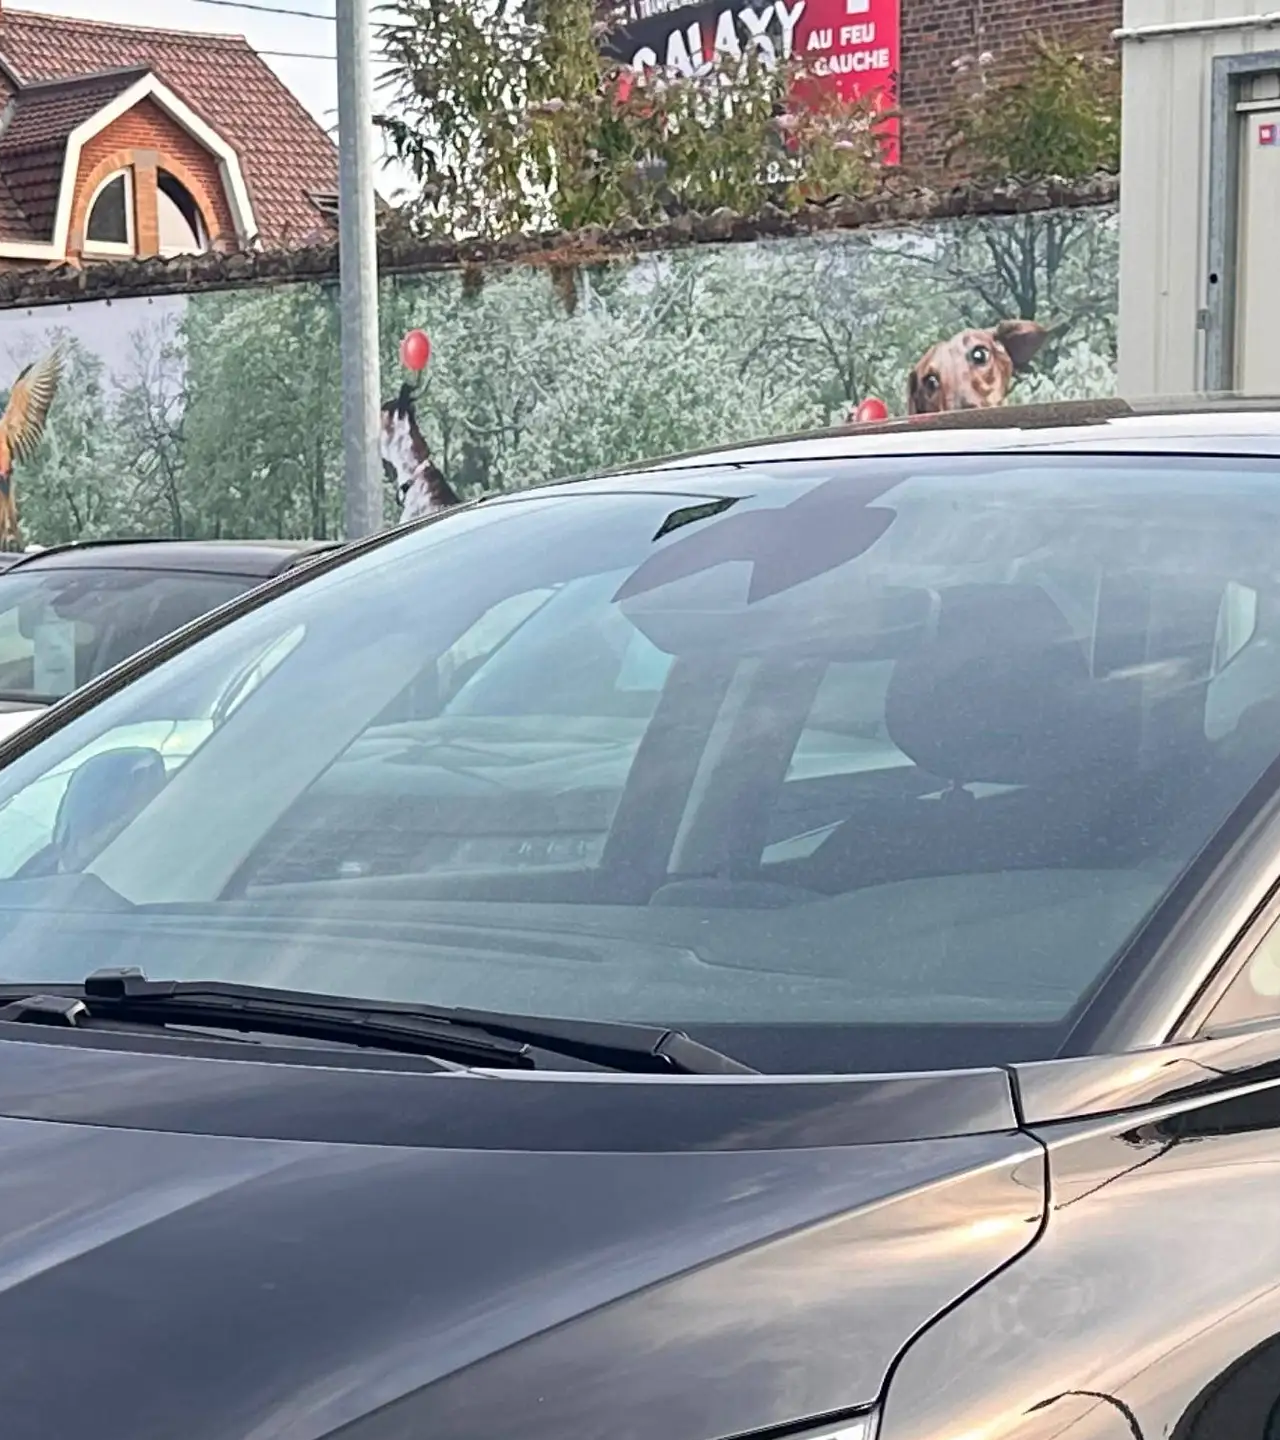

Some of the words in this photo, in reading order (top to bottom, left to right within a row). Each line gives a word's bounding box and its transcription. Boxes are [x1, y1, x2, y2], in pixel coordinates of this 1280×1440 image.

[807, 29, 832, 50] AU
[840, 22, 875, 46] FEU
[814, 48, 889, 76] GAUCHE
